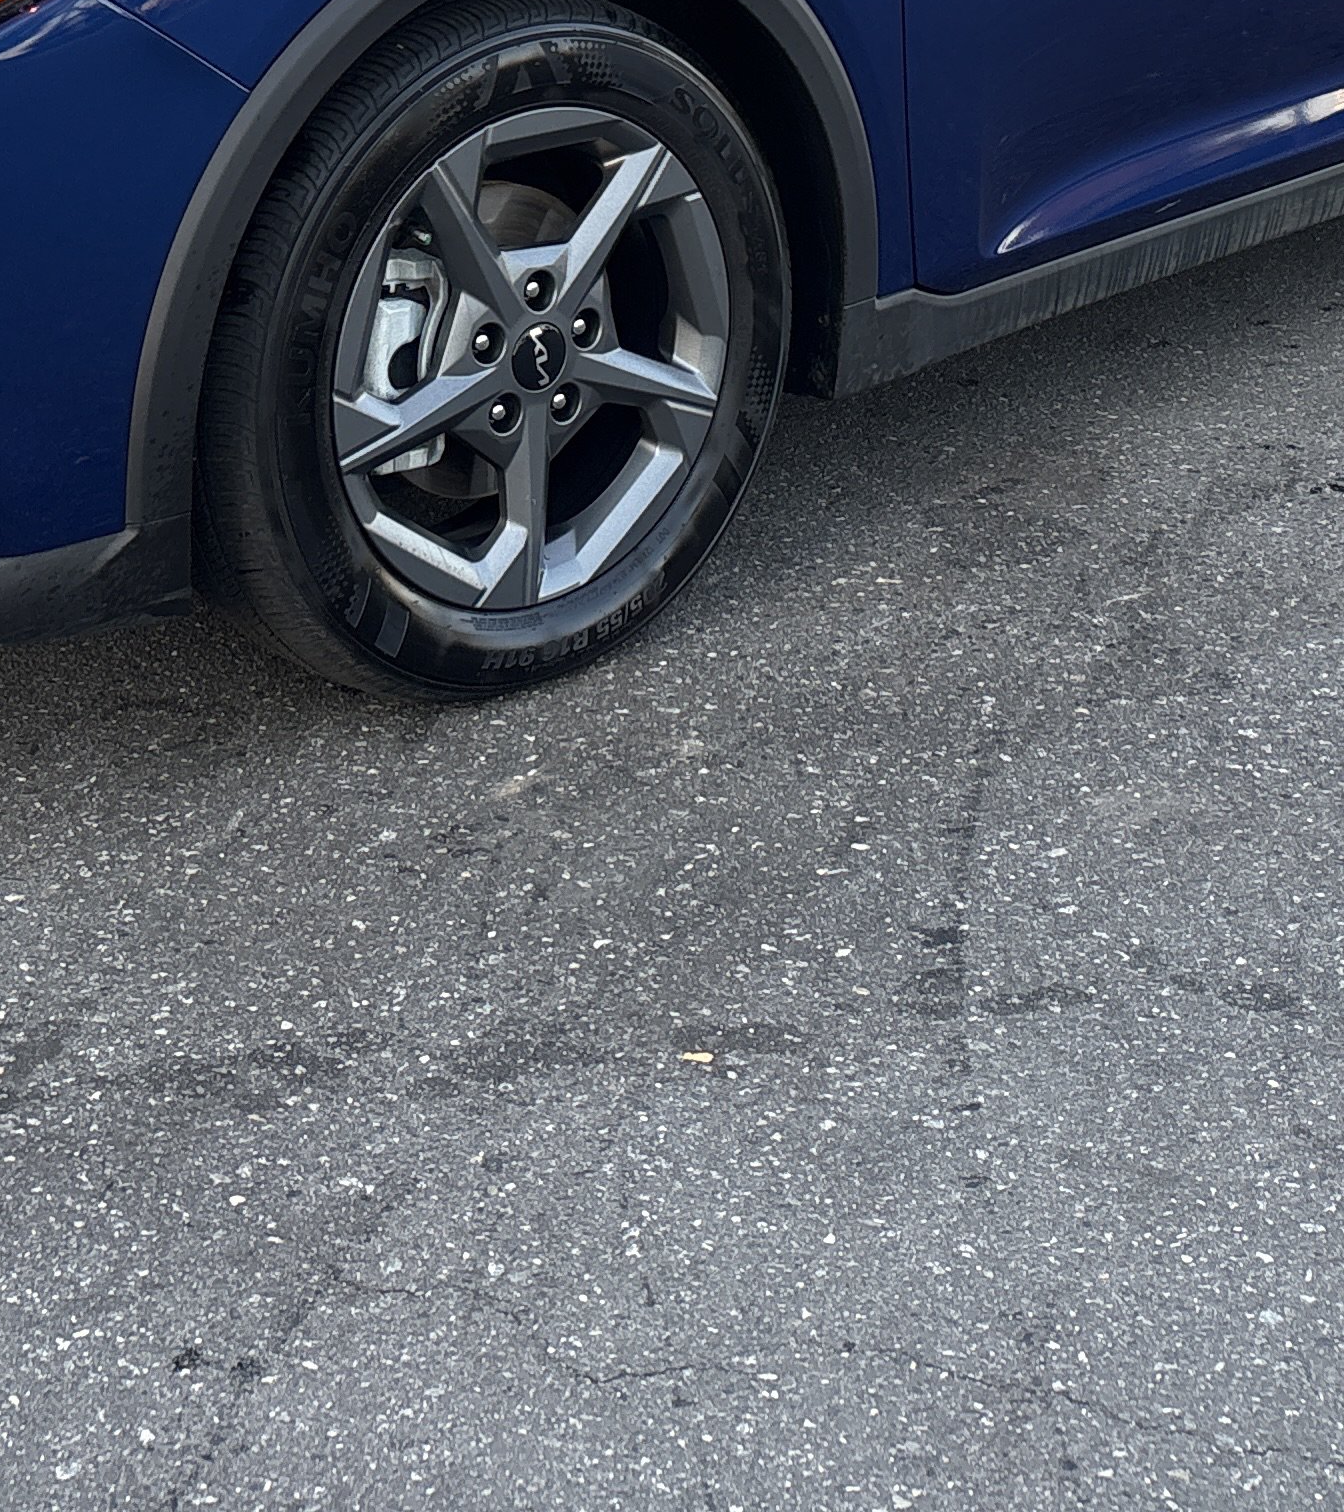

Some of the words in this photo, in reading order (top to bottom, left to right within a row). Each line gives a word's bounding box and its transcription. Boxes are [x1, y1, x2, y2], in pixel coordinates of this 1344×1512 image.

[280, 210, 358, 428] KUMHO
[479, 646, 538, 672] 91H
[543, 626, 590, 661] R16
